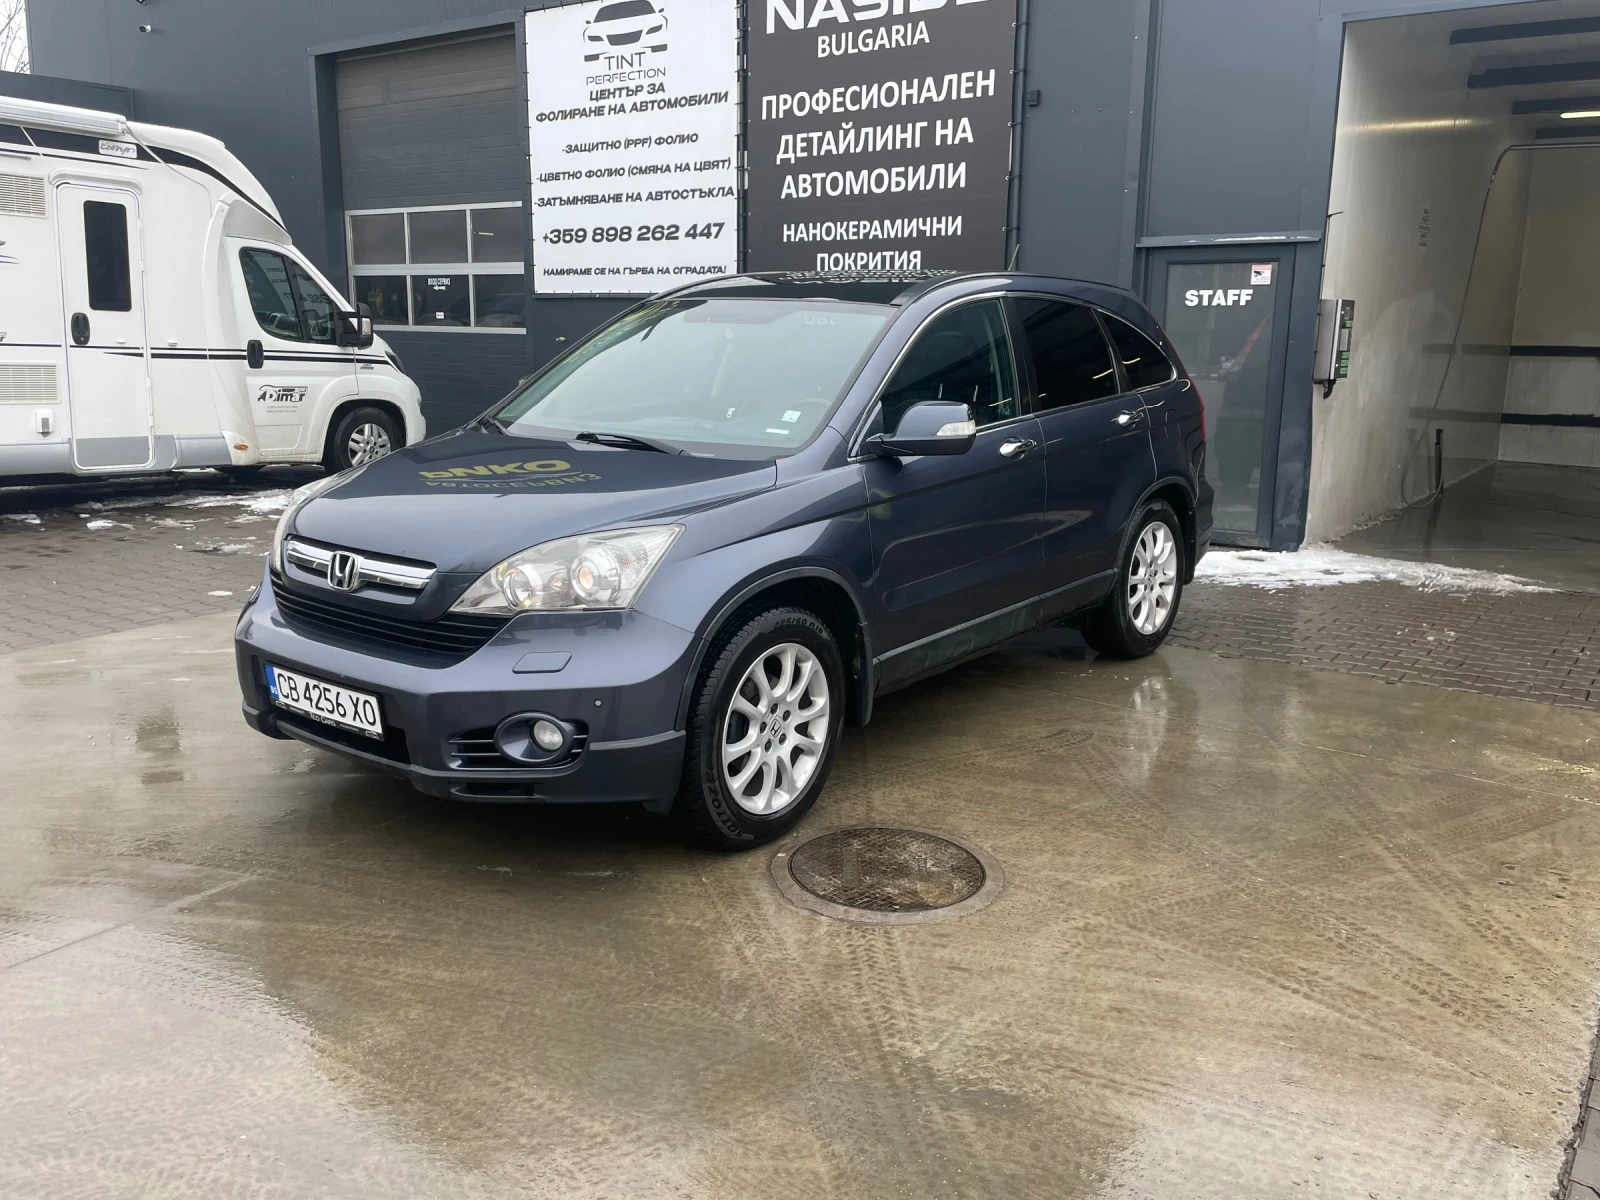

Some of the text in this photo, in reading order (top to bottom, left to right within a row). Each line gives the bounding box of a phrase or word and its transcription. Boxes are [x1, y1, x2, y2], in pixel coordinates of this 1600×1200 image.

[817, 21, 930, 58] BULGARIA
[604, 52, 646, 70] TINT
[586, 67, 666, 86] PERFECTION
[589, 82, 666, 102] ЦЕНТЪР ЗА
[761, 69, 996, 120] ПРОФЕСИОНАЛЕН
[535, 91, 729, 123] ФОЛИРАНЕ НА АВТОМОБИЛИ
[561, 133, 699, 154] -ЗАЩИТНО (PPF) ФОЛИО
[776, 117, 974, 165] ДЕТАЙЛИНГ НА
[536, 157, 731, 183] -ЦВЕТНО ФОЛИО (СМЯНА НА ЦВЯТ)
[780, 161, 967, 199] АВТОМОБИЛИ
[534, 186, 735, 207] -ЗАТЪМНЯВАНЕ НА АВТОСТЪКЛА
[542, 222, 726, 244] +359 898 262 447
[782, 215, 963, 243] НАНОКЕРАМИЧНИ
[543, 265, 727, 276] НАМИРАМЕ СЕ НА ГЪРБА НА СГРАДАТА!
[816, 250, 922, 271] ПОКРИТИЯ
[1184, 289, 1254, 307] STAFF
[277, 672, 377, 727] CB 4256 XO
